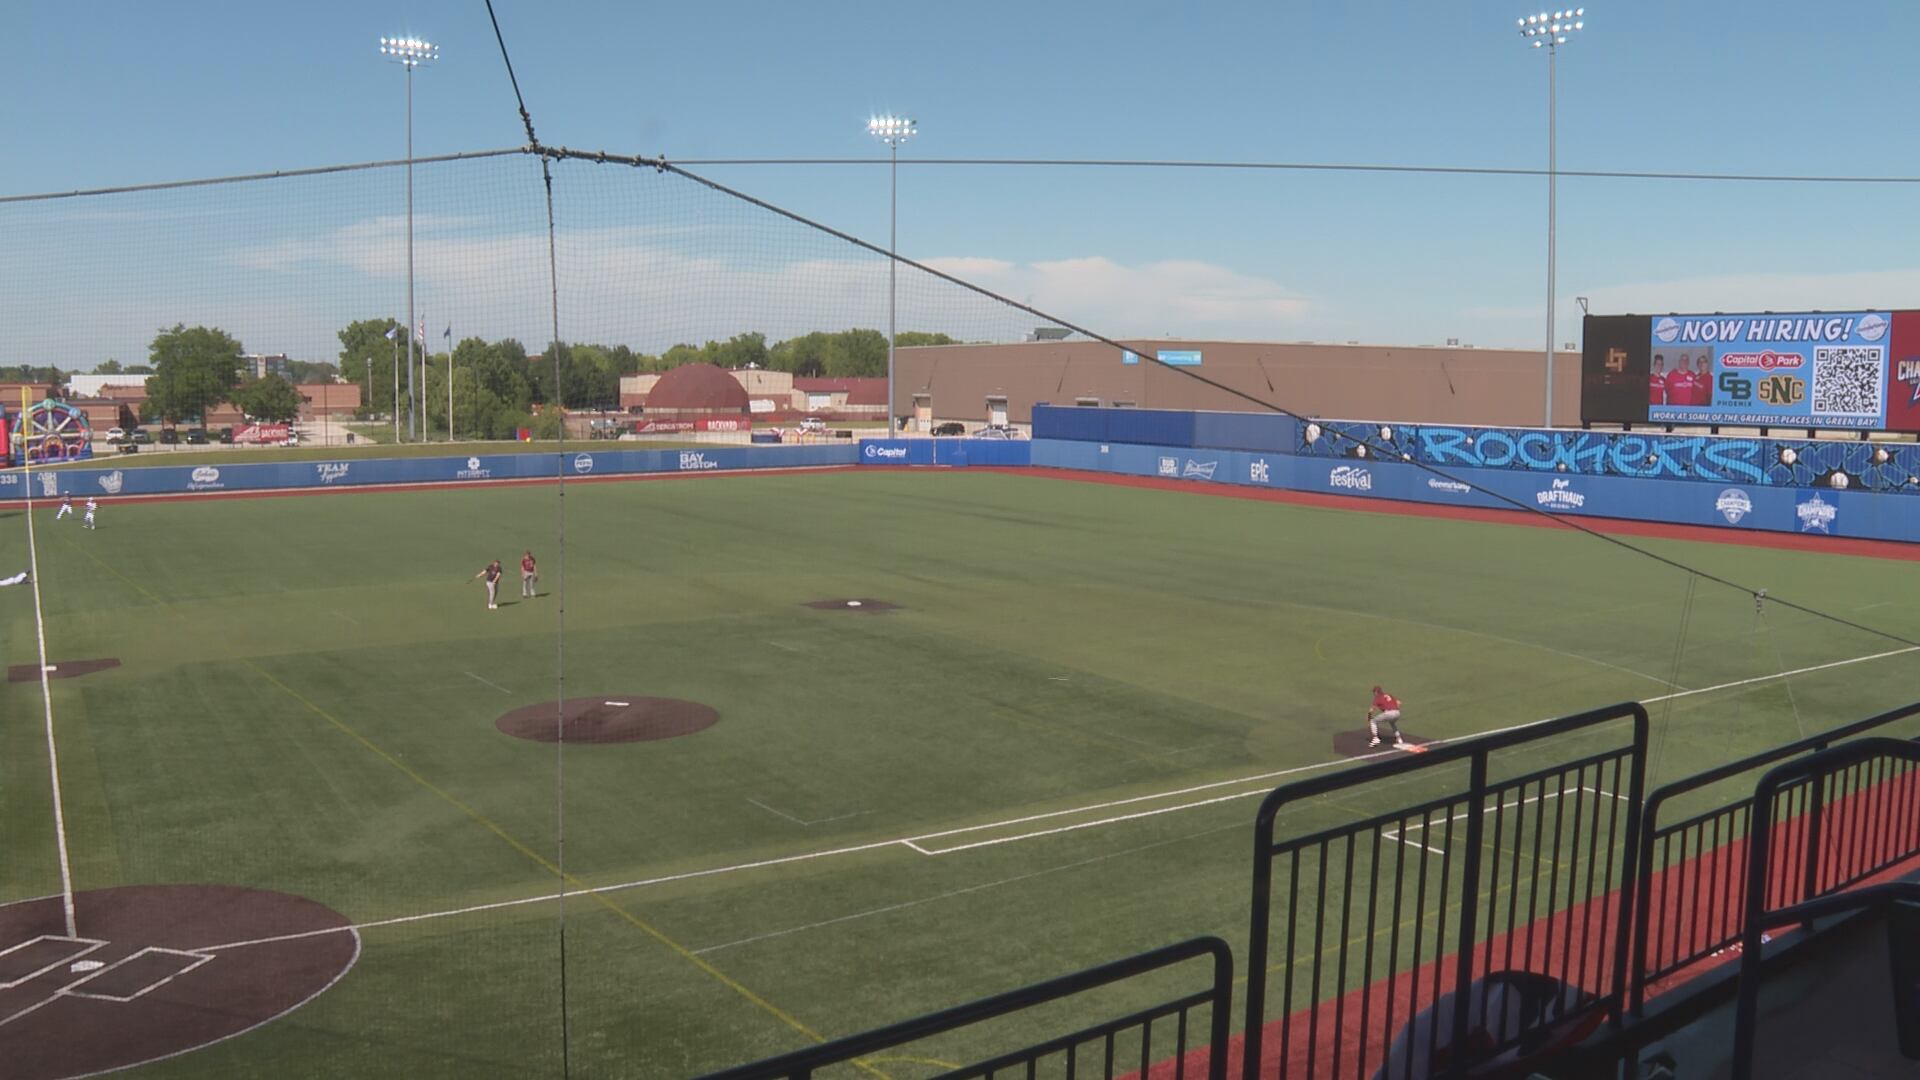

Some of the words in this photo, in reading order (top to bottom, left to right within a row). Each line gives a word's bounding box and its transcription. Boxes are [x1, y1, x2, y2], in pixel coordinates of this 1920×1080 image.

[1681, 318, 1743, 342] NOW
[1745, 317, 1855, 342] HIRING!
[1726, 355, 1759, 365] Capital
[1777, 356, 1800, 365] Park
[1759, 376, 1804, 404] SNC
[1653, 411, 1675, 420] WORK
[1678, 412, 1687, 420] AT
[1688, 412, 1710, 421] SOME
[1711, 413, 1722, 421] OF
[1724, 414, 1738, 422] THE
[1740, 414, 1778, 423] GREATEST
[1780, 415, 1811, 424] PLACES
[1825, 417, 1854, 425] GREEN
[1857, 417, 1878, 426] BAY!
[680, 453, 704, 463] BAY
[877, 447, 907, 457] Capital
[316, 463, 349, 472] TEAM
[680, 461, 718, 469] CUSTOM
[1330, 466, 1372, 490] festival
[1536, 490, 1585, 507] DRAFTHAUS
